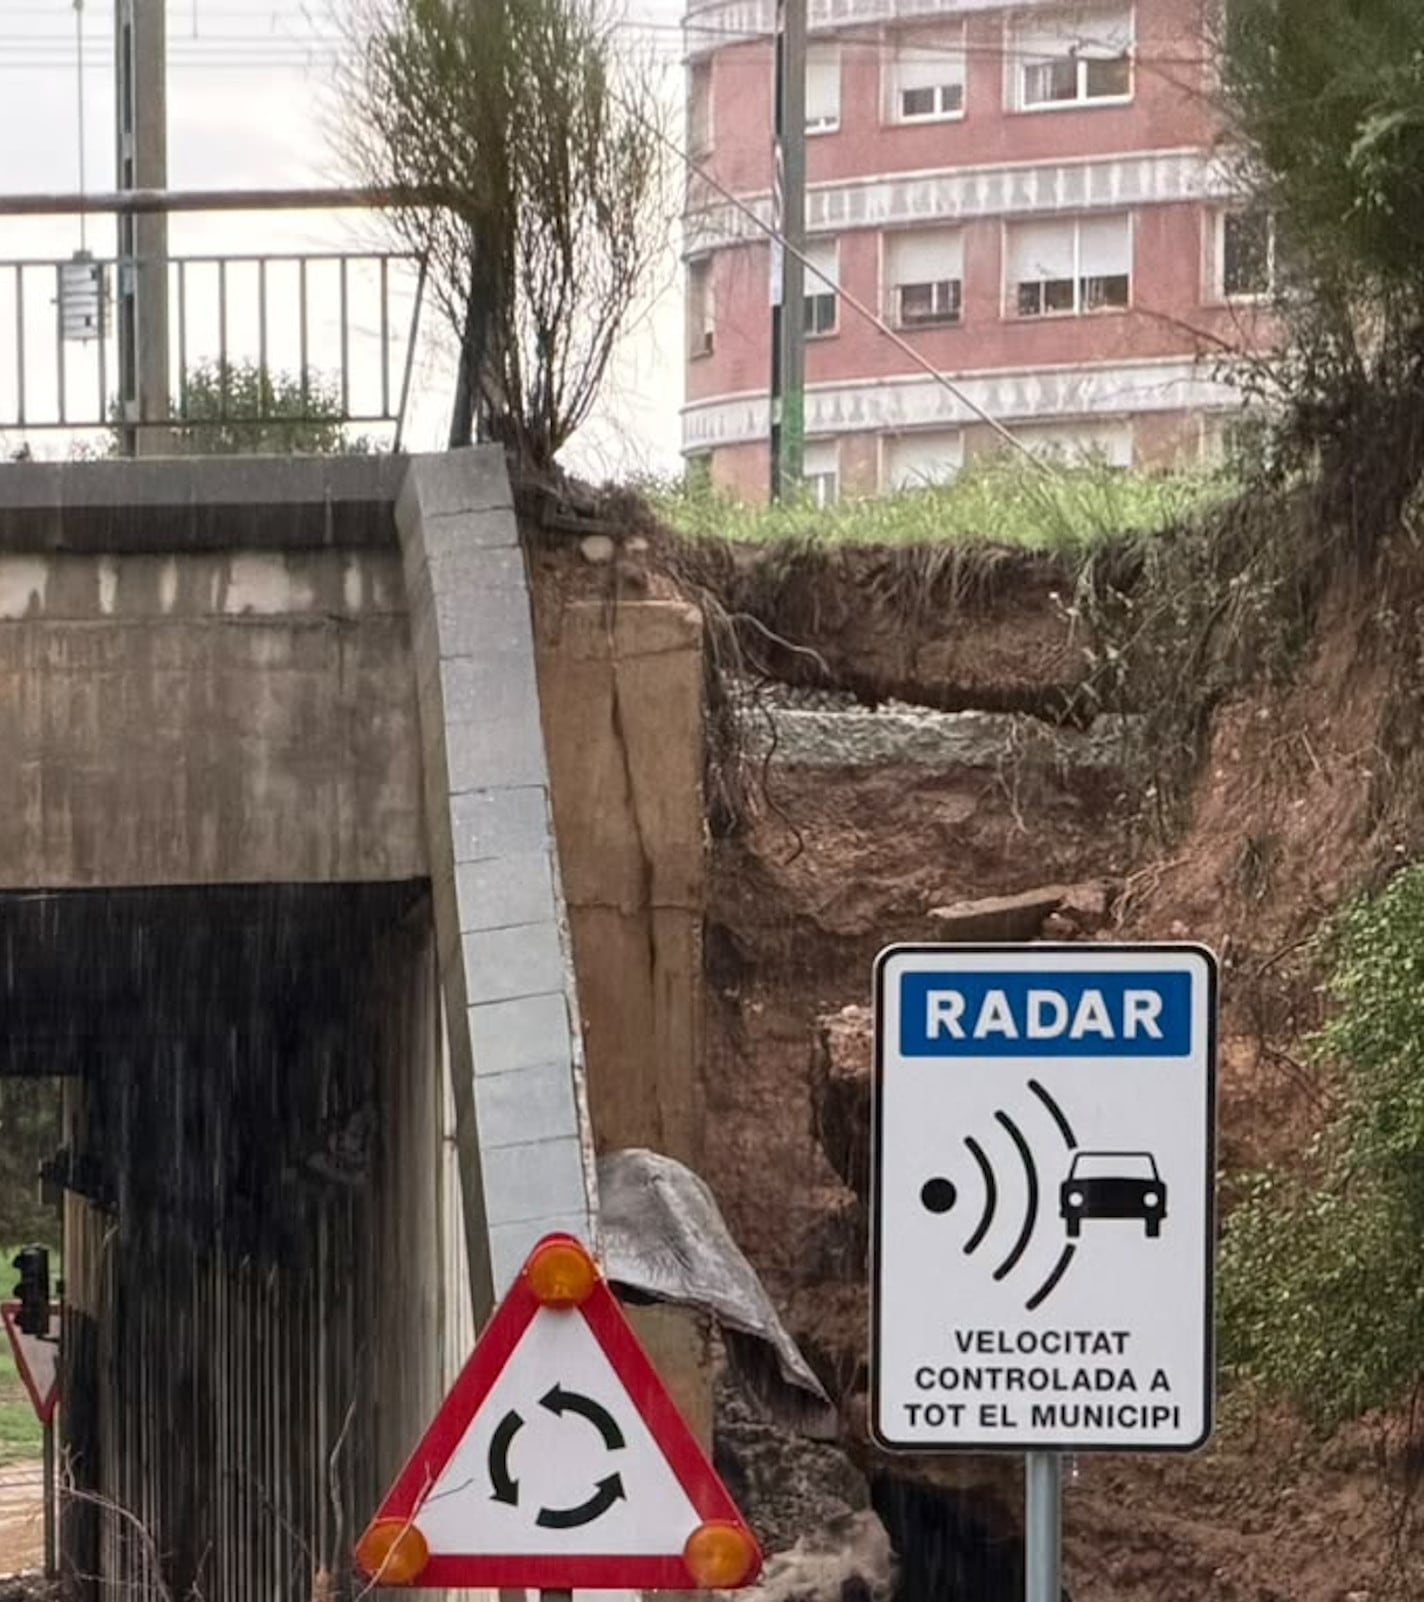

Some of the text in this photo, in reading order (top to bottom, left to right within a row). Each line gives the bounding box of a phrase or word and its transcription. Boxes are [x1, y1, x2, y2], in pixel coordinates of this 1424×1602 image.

[925, 989, 1164, 1039] RADAR
[954, 1331, 1131, 1355] VELOCITAT
[915, 1367, 1171, 1392] CONTROLADA A
[904, 1403, 1180, 1429] TOT EL MUNICIPI
